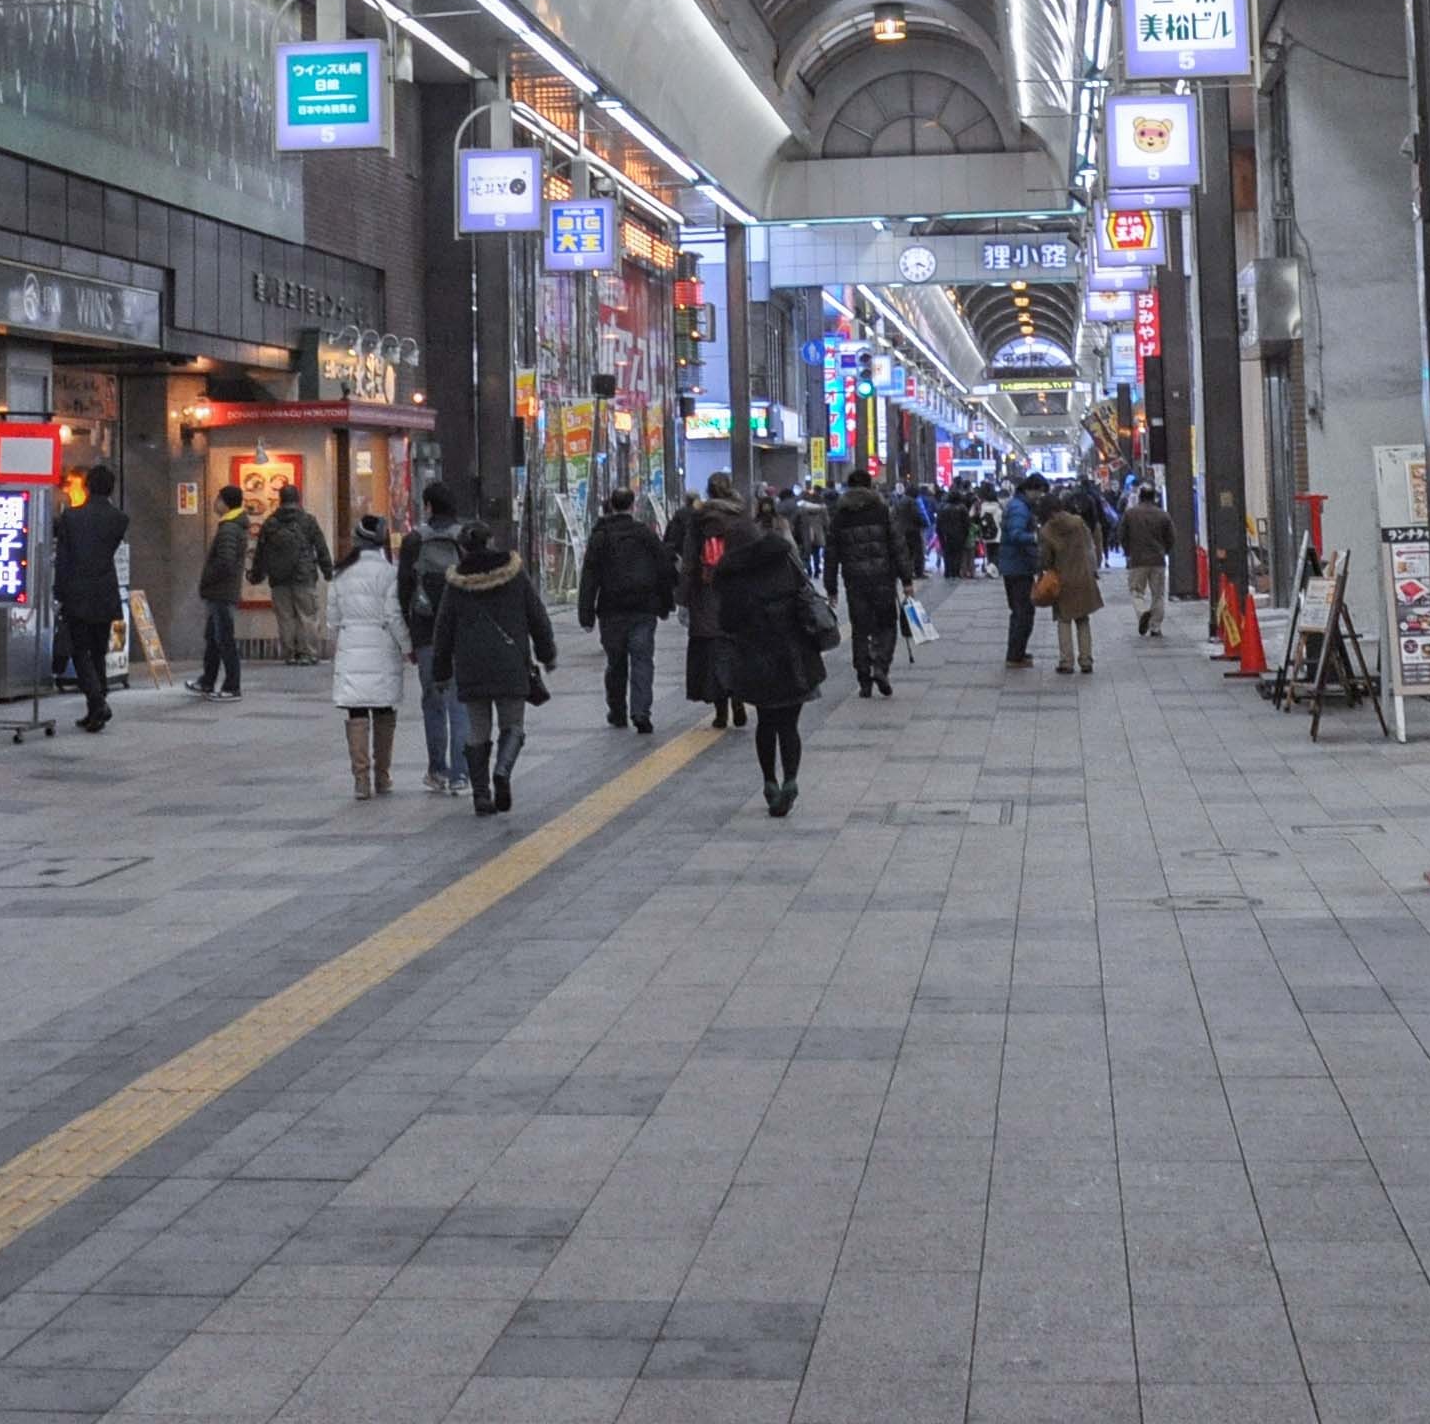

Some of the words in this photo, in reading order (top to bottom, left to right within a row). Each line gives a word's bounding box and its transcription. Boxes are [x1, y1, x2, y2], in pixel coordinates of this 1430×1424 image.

[1139, 11, 1232, 42] 美松ビル
[1179, 51, 1195, 69] 5
[320, 127, 336, 143] 5
[984, 244, 1067, 270] 狸小路
[1138, 294, 1159, 357] おみやげ
